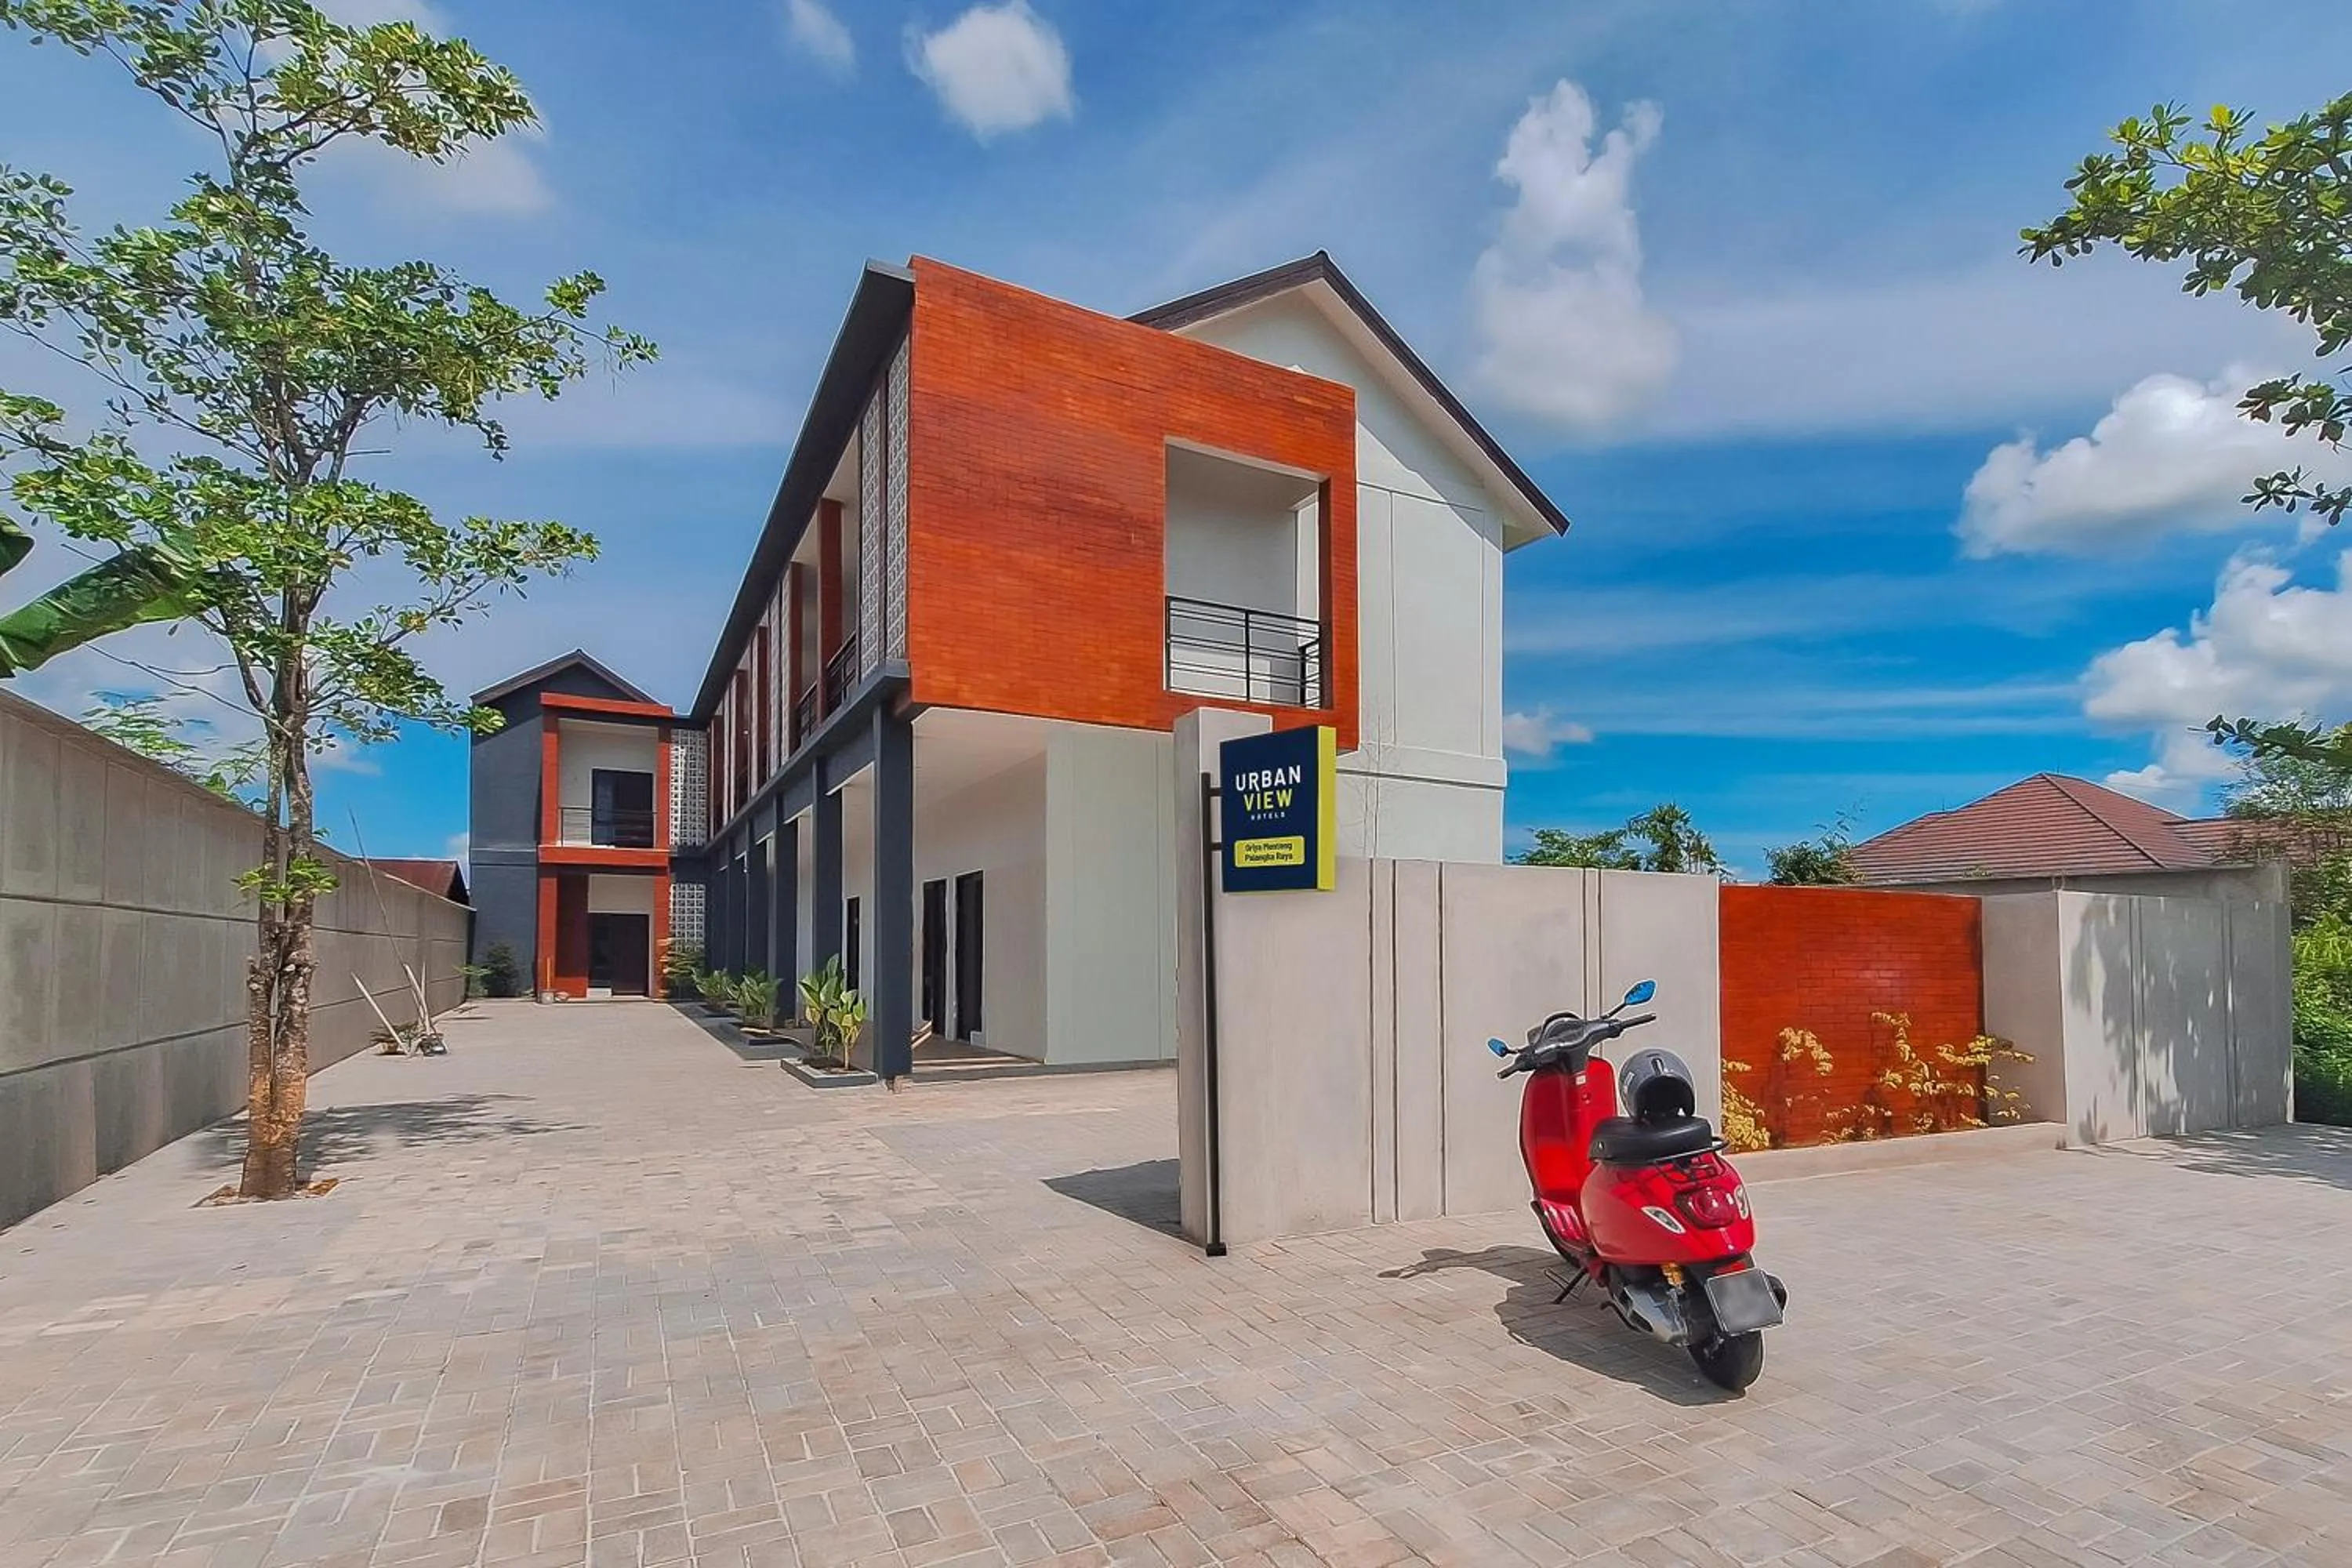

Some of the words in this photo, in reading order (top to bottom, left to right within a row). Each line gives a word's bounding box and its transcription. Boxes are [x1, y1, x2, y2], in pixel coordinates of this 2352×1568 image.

[1236, 765, 1301, 791] URBAN
[1243, 789, 1292, 811] VIEW
[1250, 811, 1285, 821] HOTELS
[1276, 852, 1293, 861] Raya
